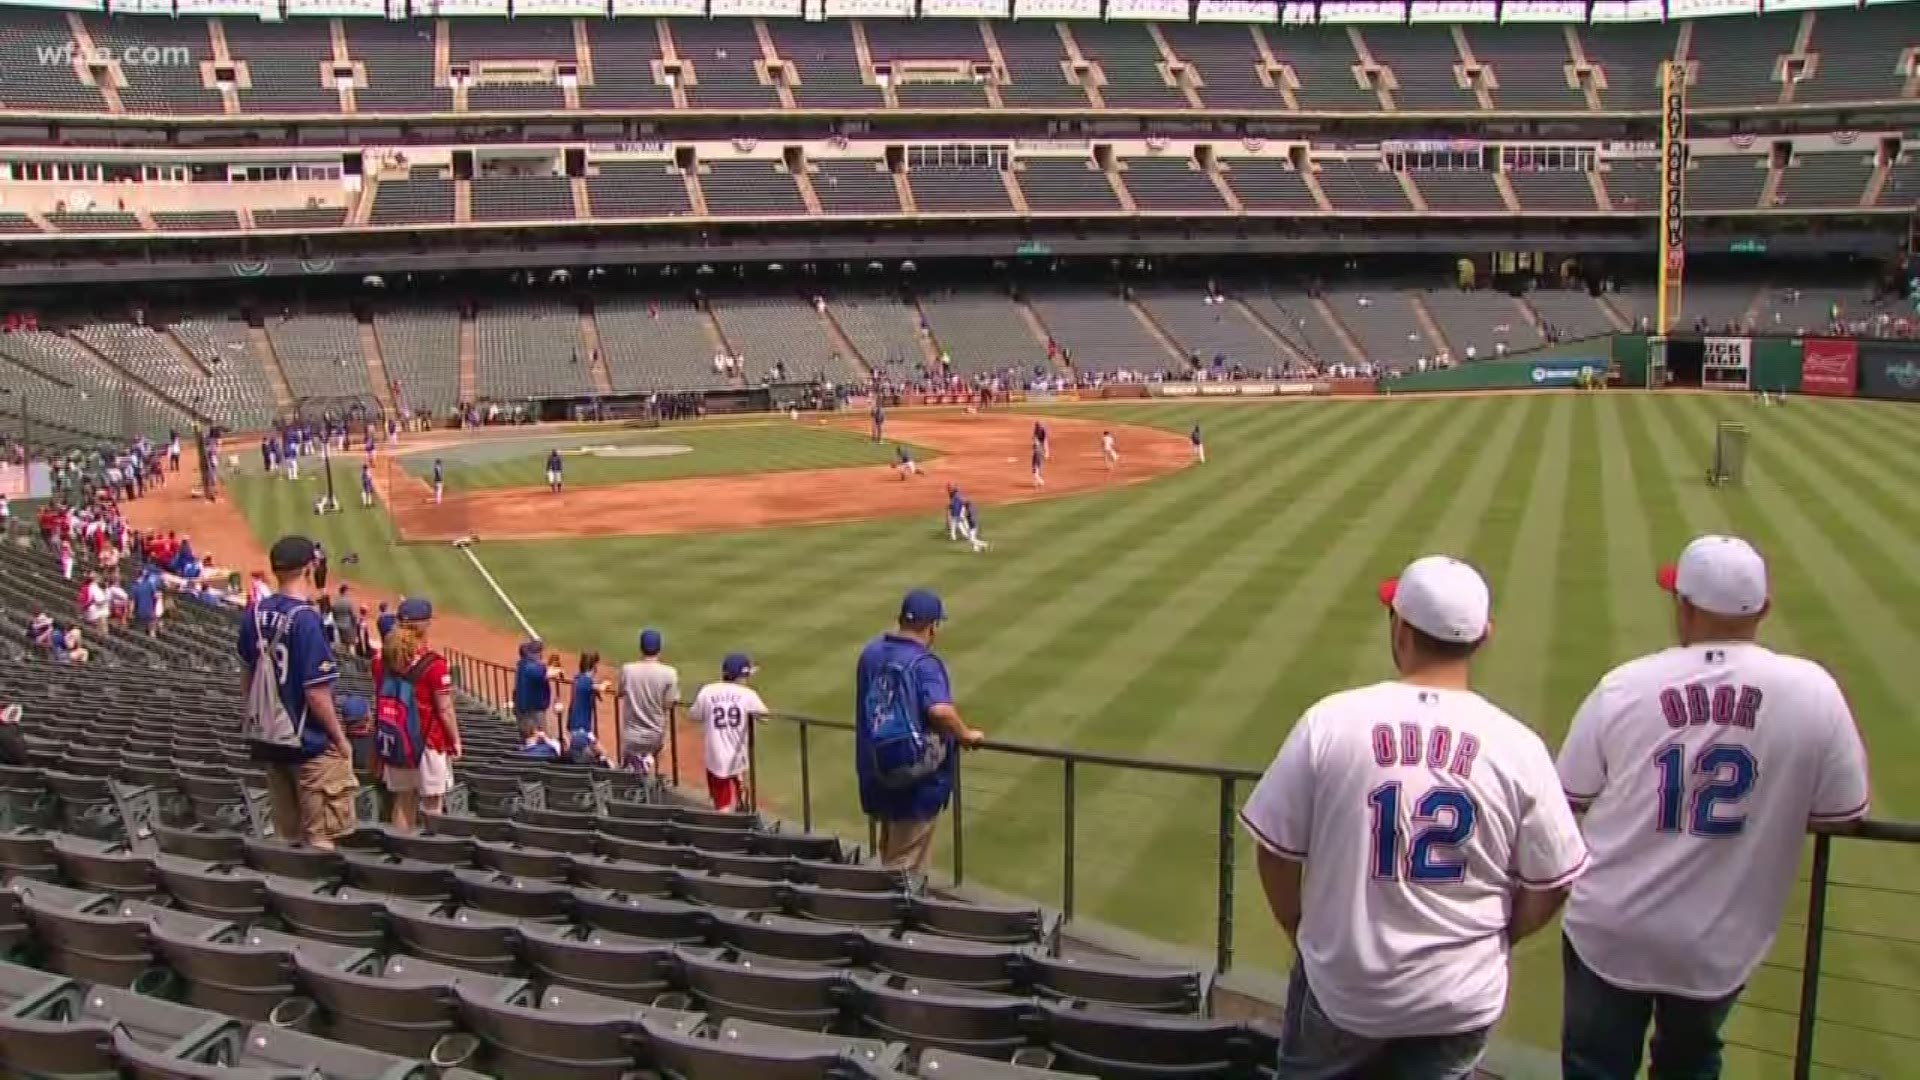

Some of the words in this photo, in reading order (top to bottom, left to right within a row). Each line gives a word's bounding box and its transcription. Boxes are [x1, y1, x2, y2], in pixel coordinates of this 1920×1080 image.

[712, 706, 742, 729] 29
[1658, 683, 1763, 731] ODOR
[1371, 722, 1482, 779] ODOR
[1653, 743, 1759, 839] 12
[1367, 780, 1479, 883] 12
